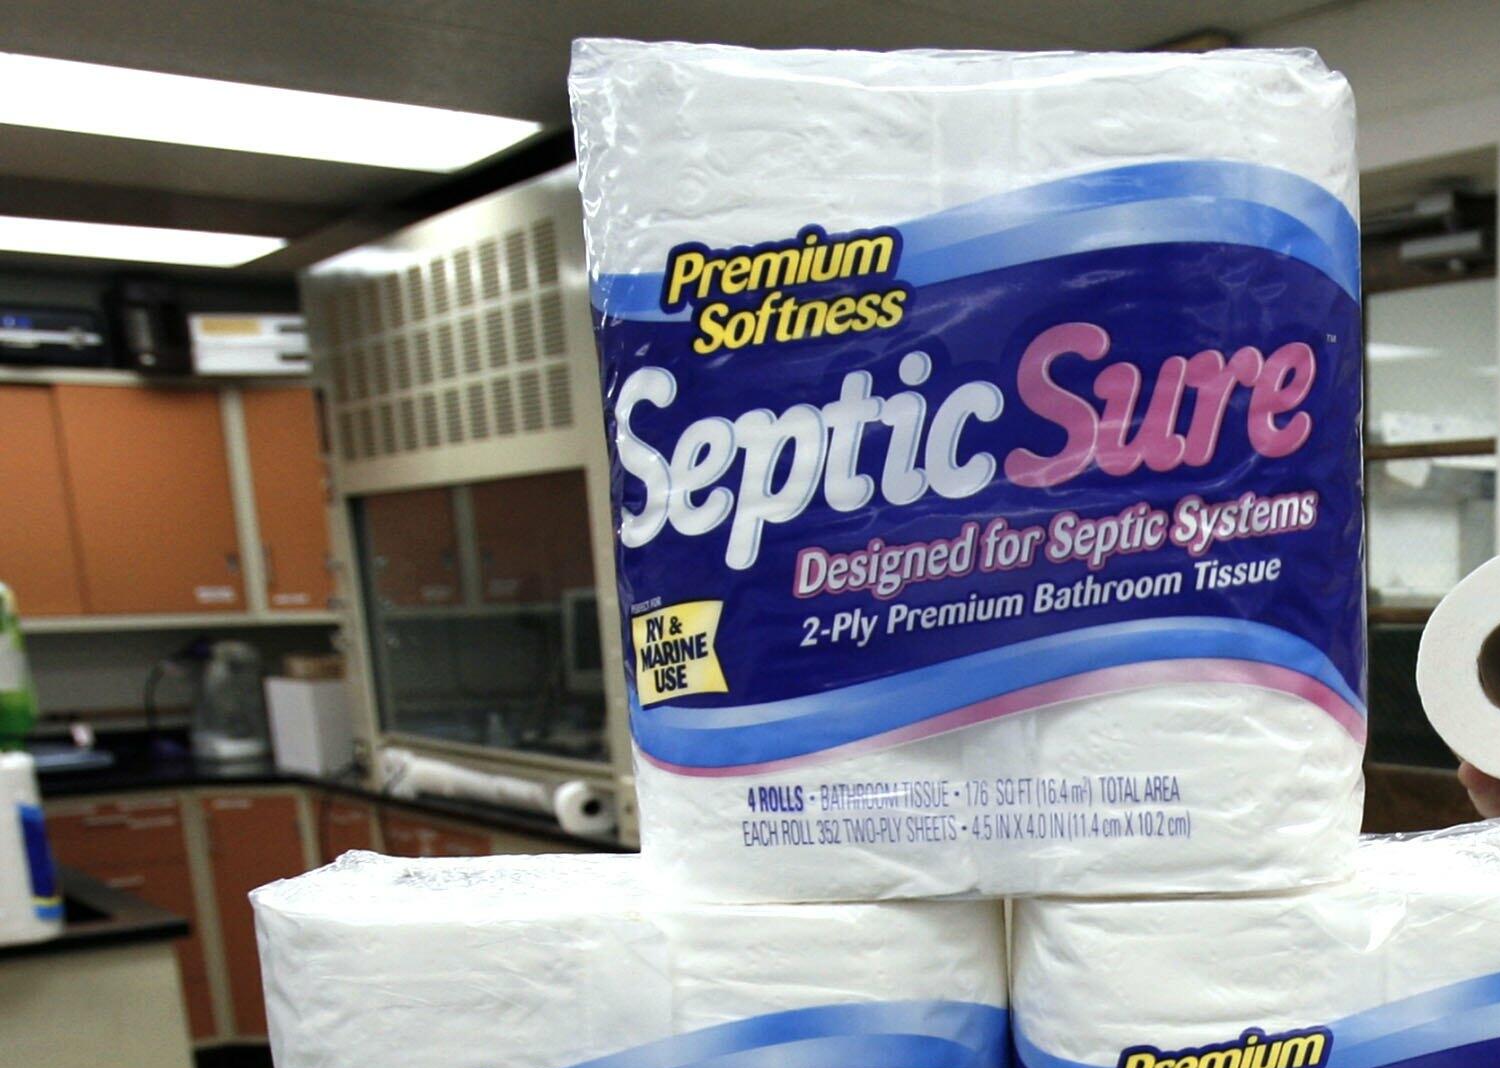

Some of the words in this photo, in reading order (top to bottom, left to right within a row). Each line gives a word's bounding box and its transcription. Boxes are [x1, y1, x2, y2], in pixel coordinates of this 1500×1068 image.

[668, 235, 893, 304] Premium
[694, 290, 906, 353] Softness
[797, 525, 977, 596] Designed
[983, 521, 1042, 567] for
[1050, 508, 1164, 566] Septic
[1173, 494, 1316, 552] Systems
[800, 608, 879, 648] 2-Ply
[886, 593, 1023, 634] Premium
[1033, 571, 1182, 614] Bathroom
[1194, 557, 1281, 591] Tissue
[646, 615, 664, 643] RV
[669, 616, 682, 635] &
[641, 632, 708, 672] MARINE
[654, 664, 687, 693] USE
[748, 787, 756, 812] 4
[759, 785, 804, 812] ROLLS
[820, 783, 898, 811] BATHROOM
[902, 780, 949, 808] TISSUE
[966, 780, 988, 806] 176
[996, 778, 1014, 806] SQ
[1018, 778, 1031, 805] FT
[1036, 778, 1068, 806] (16.4
[1100, 776, 1140, 803] TOTAL
[1144, 776, 1181, 802] AREA
[742, 820, 777, 847] EACH
[781, 819, 814, 845] ROLL
[817, 819, 841, 844] 352
[843, 816, 901, 844] TWO-PLY
[906, 815, 957, 843] SHEETS
[972, 814, 992, 840] 4.5
[996, 814, 1009, 839] IN
[1014, 814, 1024, 839] X
[1026, 813, 1046, 839] 4.0
[1050, 812, 1064, 838] IN
[1068, 812, 1099, 841] (11.4
[1102, 817, 1120, 837] cm
[1124, 811, 1134, 837] X
[1138, 810, 1164, 837] 10.2
[1167, 810, 1191, 838] cm)
